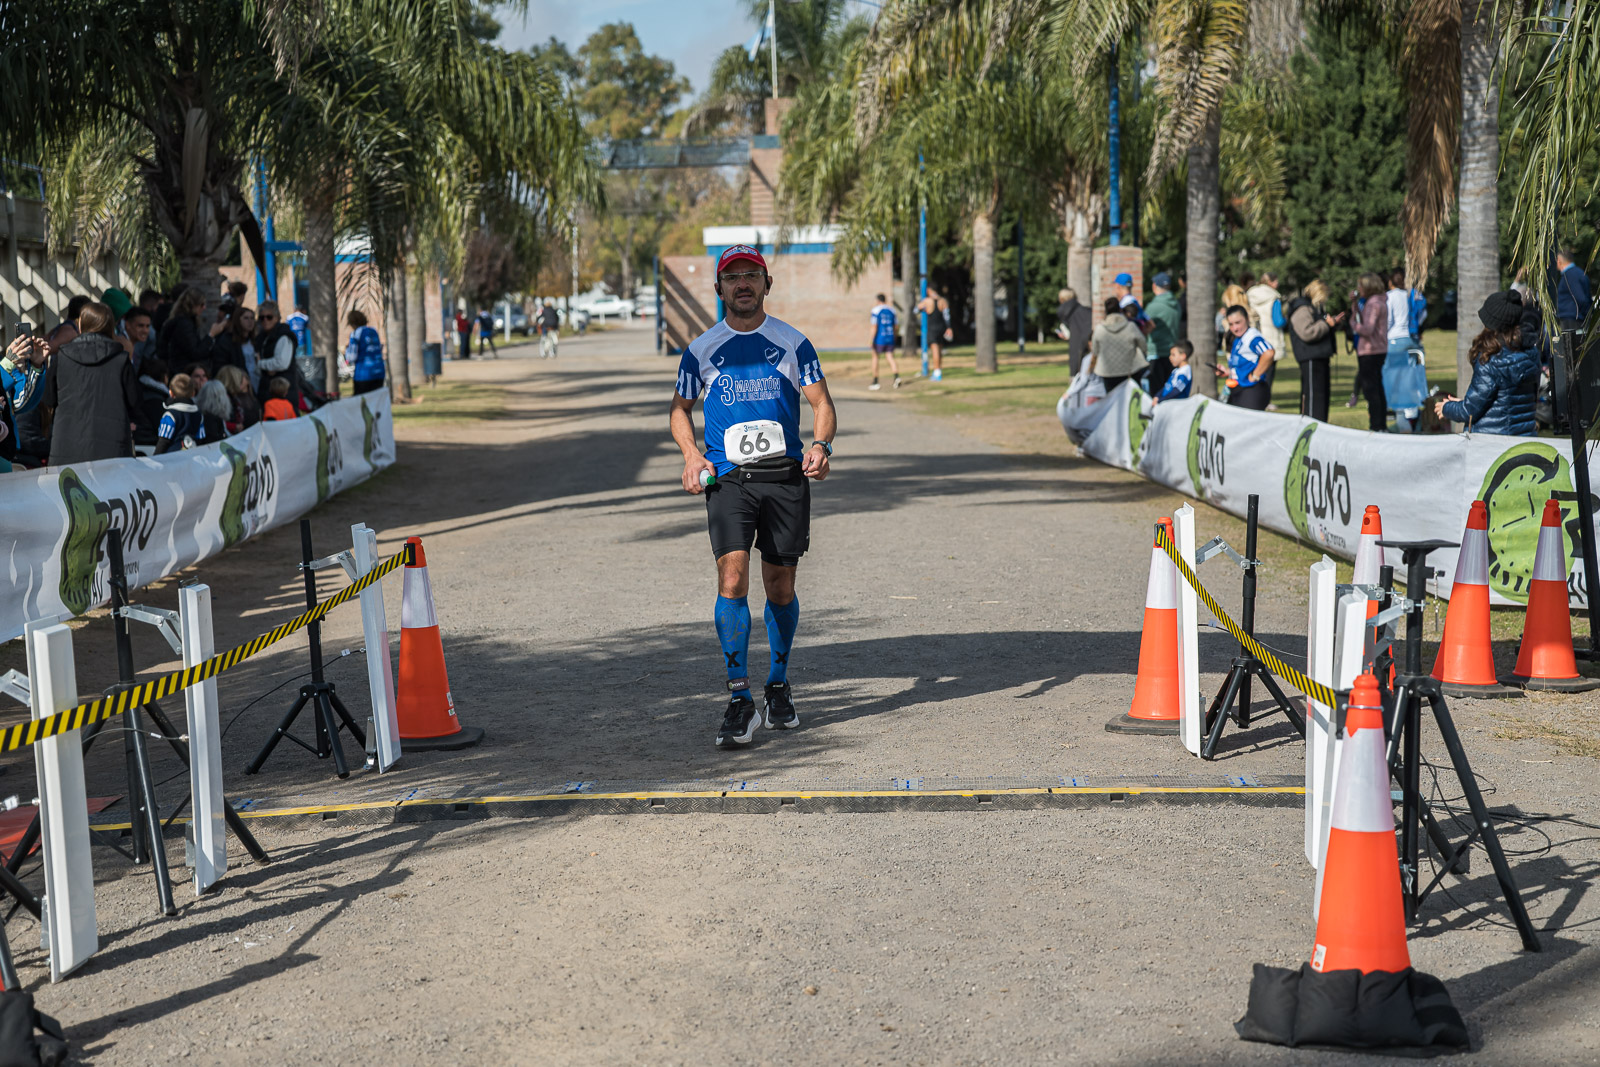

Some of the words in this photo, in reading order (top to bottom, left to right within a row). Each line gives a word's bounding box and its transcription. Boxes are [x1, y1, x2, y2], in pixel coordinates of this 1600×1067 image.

[719, 374, 736, 406] 3
[734, 375, 781, 393] MARATÓN
[739, 432, 771, 455] 66
